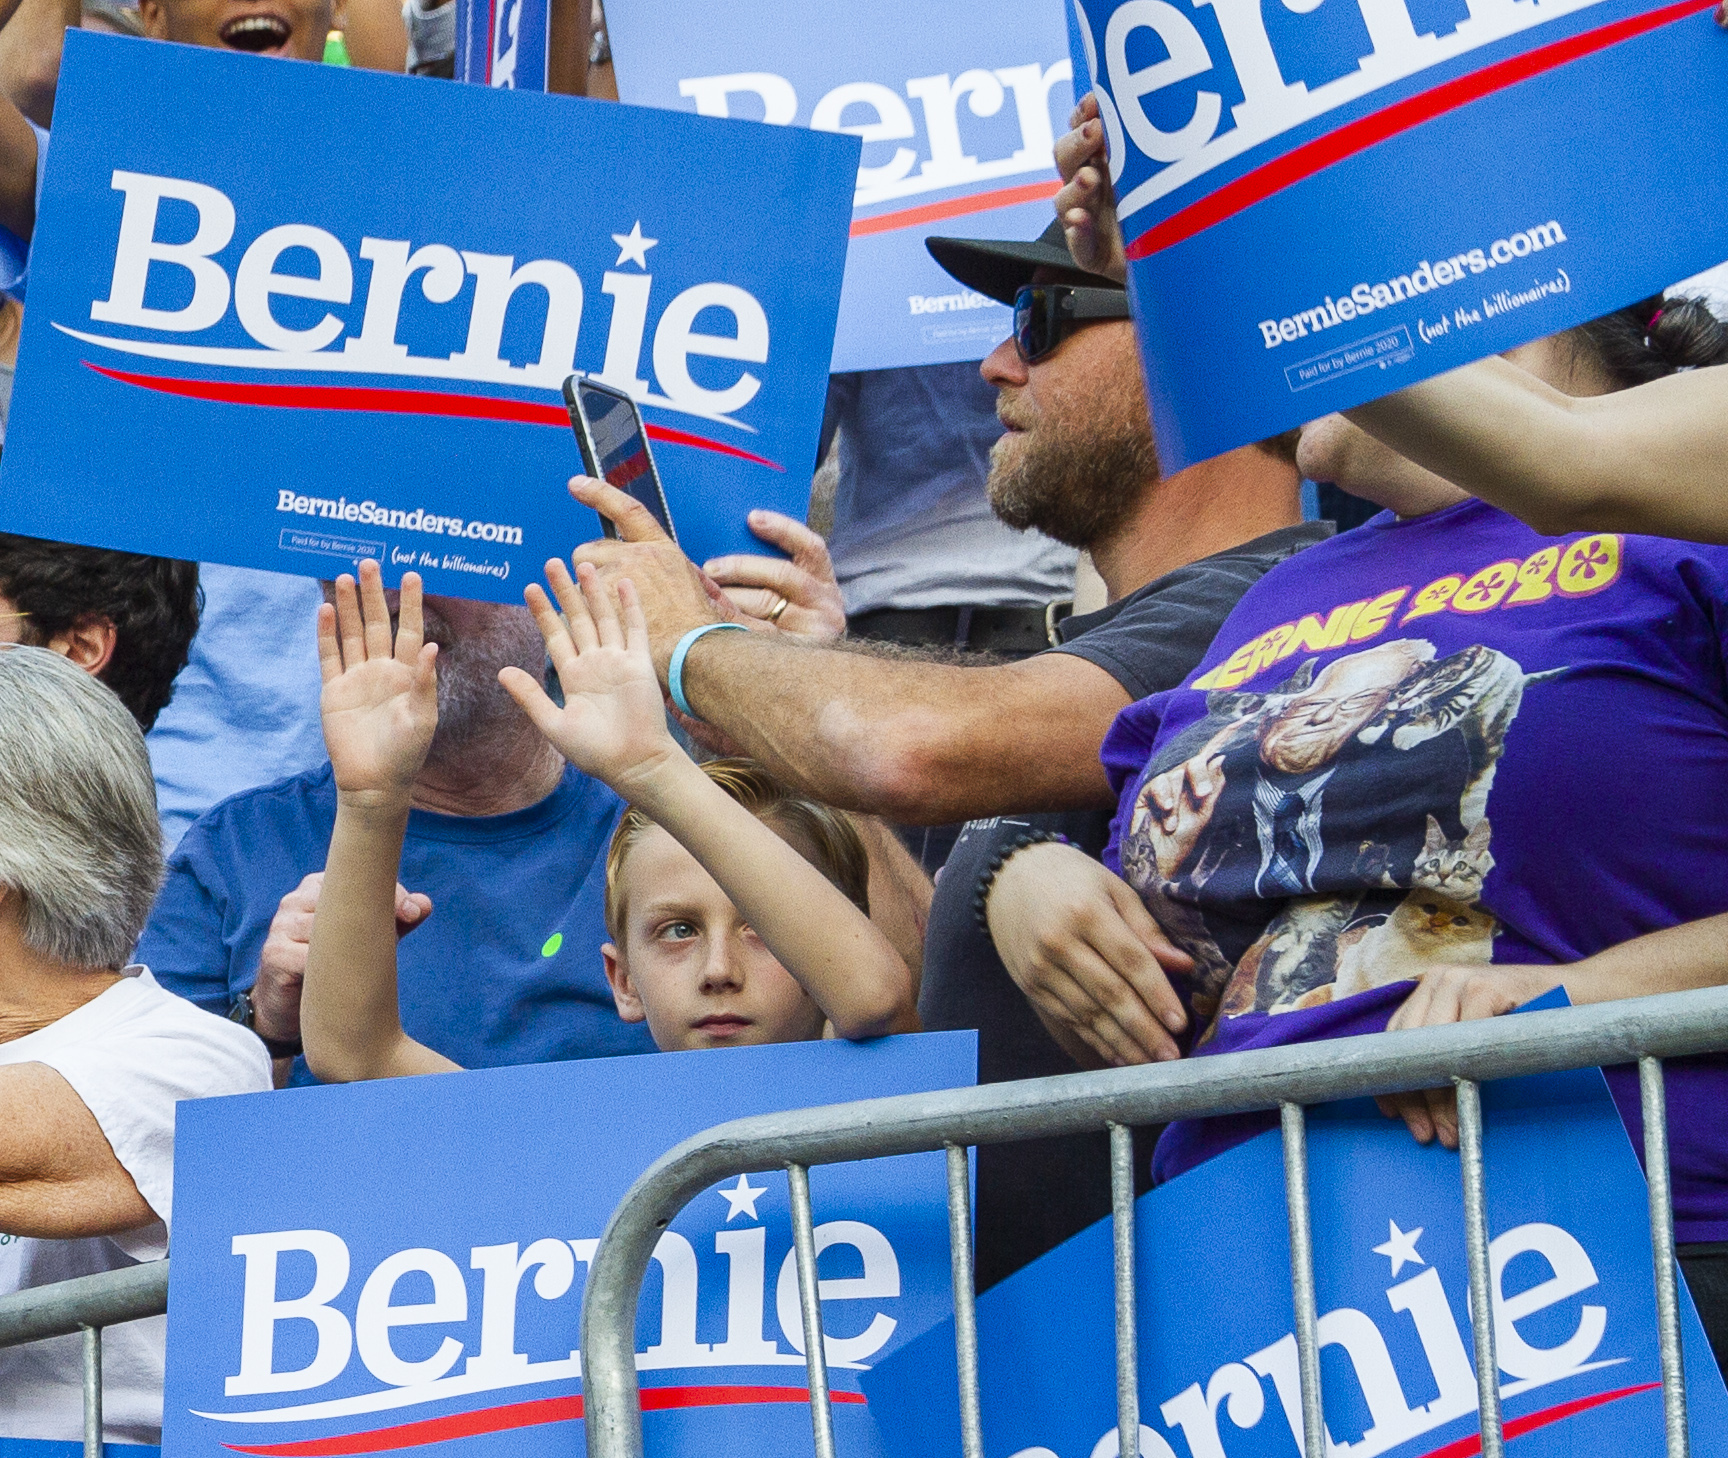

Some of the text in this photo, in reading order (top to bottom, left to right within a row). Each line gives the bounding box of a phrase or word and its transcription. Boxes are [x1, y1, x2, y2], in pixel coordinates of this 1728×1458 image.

[90, 170, 770, 414] Bernie
[1258, 220, 1567, 349] BernieSanders.com
[1455, 308, 1482, 327] the
[1484, 268, 1571, 318] billionaires)
[276, 489, 523, 545] BernieSanders.com
[420, 549, 439, 569] the
[442, 552, 510, 580] billionaires)
[1397, 533, 1624, 627] 2020
